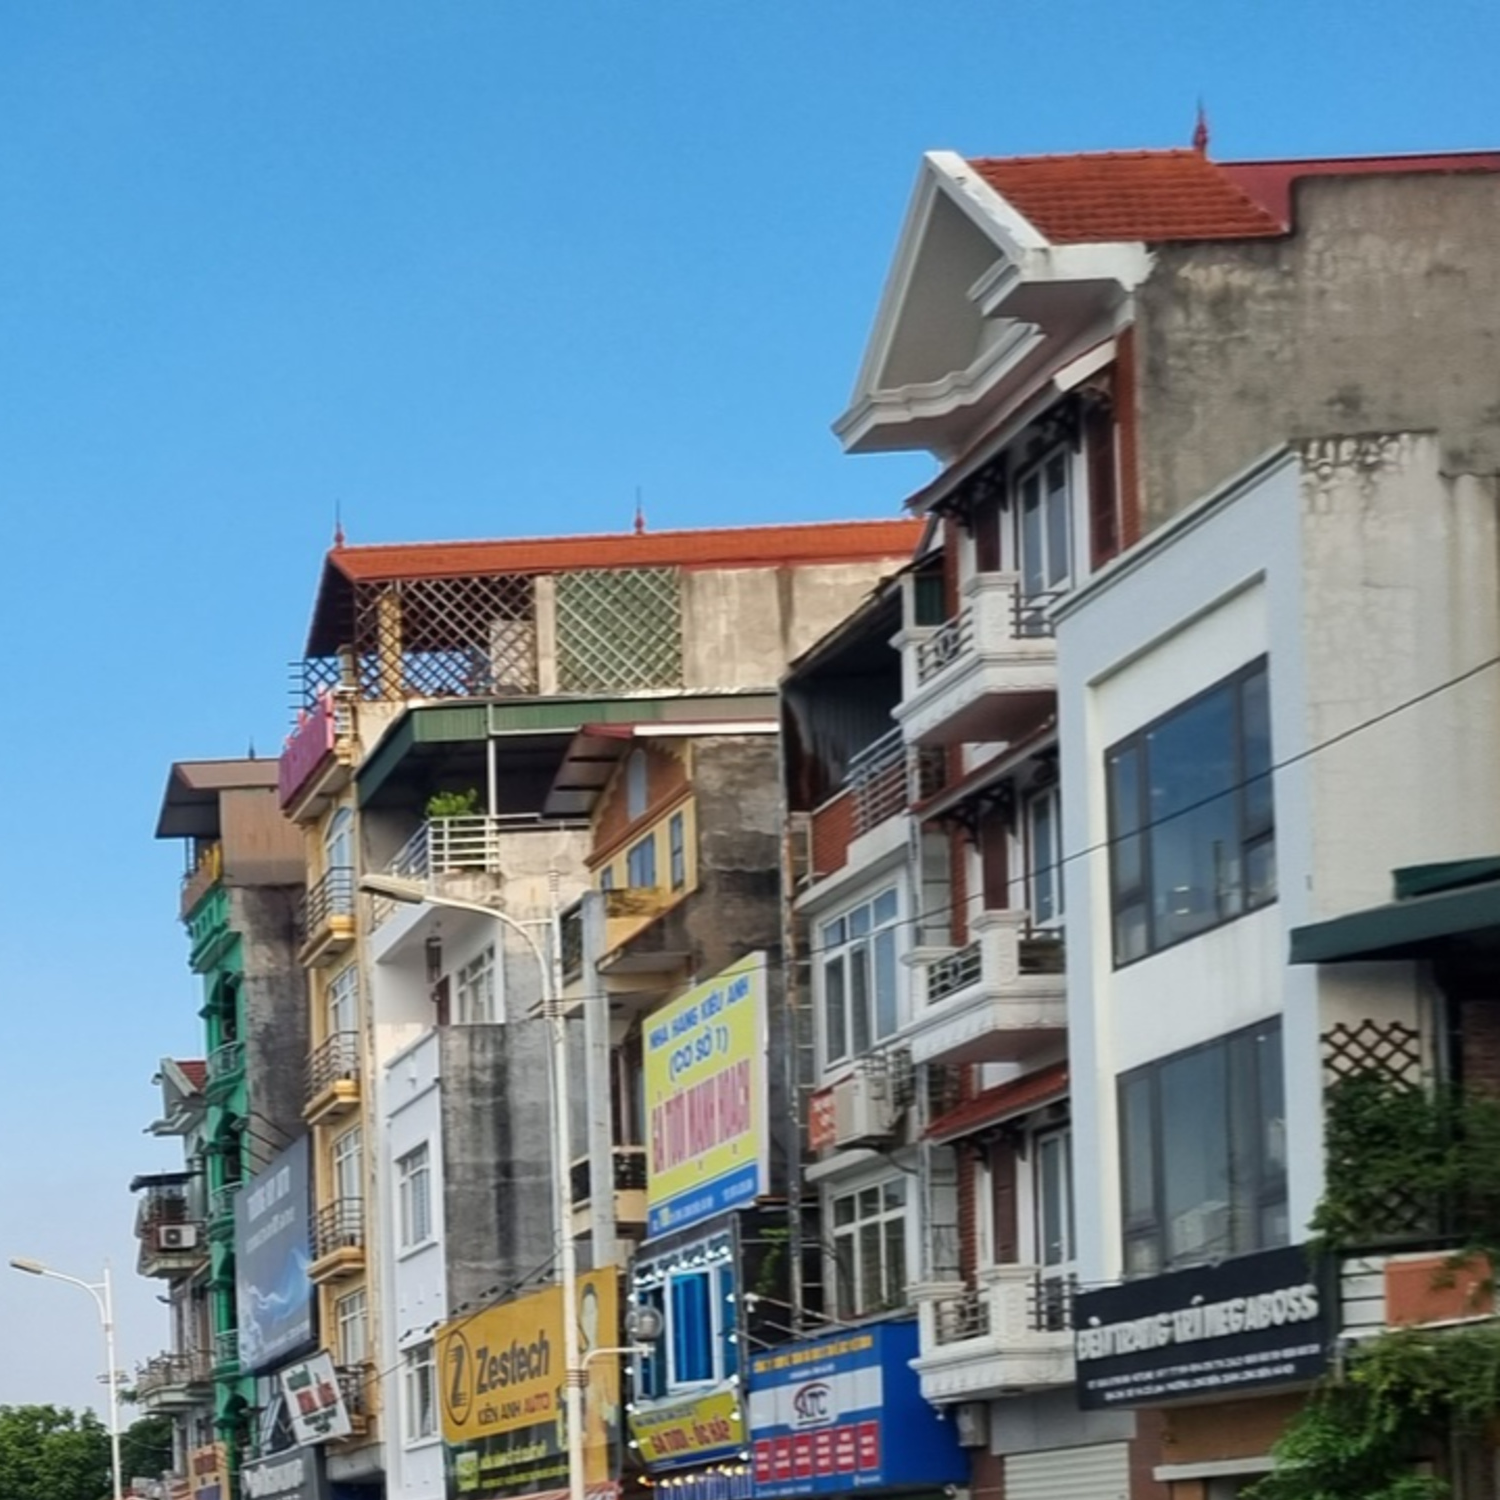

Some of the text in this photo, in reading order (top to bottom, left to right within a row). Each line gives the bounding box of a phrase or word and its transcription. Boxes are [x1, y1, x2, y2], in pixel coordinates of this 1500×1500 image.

[1204, 1283, 1320, 1339] MEGABOSS
[475, 1328, 550, 1396] Zestech
[524, 1391, 550, 1414] AUTO
